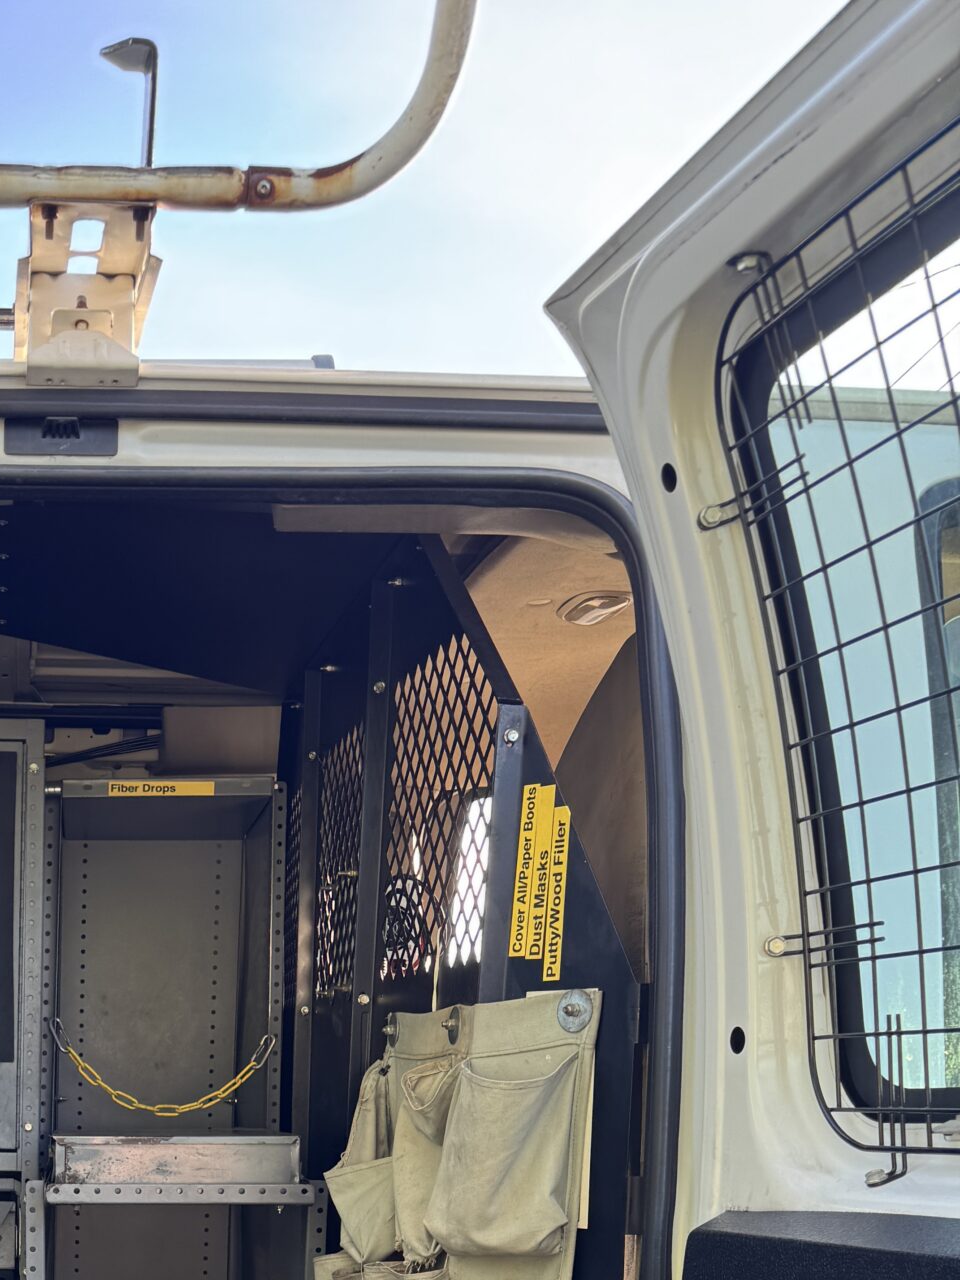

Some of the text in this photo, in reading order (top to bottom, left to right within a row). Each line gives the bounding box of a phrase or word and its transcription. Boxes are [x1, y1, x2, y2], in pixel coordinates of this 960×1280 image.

[110, 783, 176, 795] Fiber Drops
[512, 786, 537, 953] Cover All/Paper Boots
[529, 850, 549, 956] Dust Masks
[546, 820, 566, 978] Putty/Wood Filler
